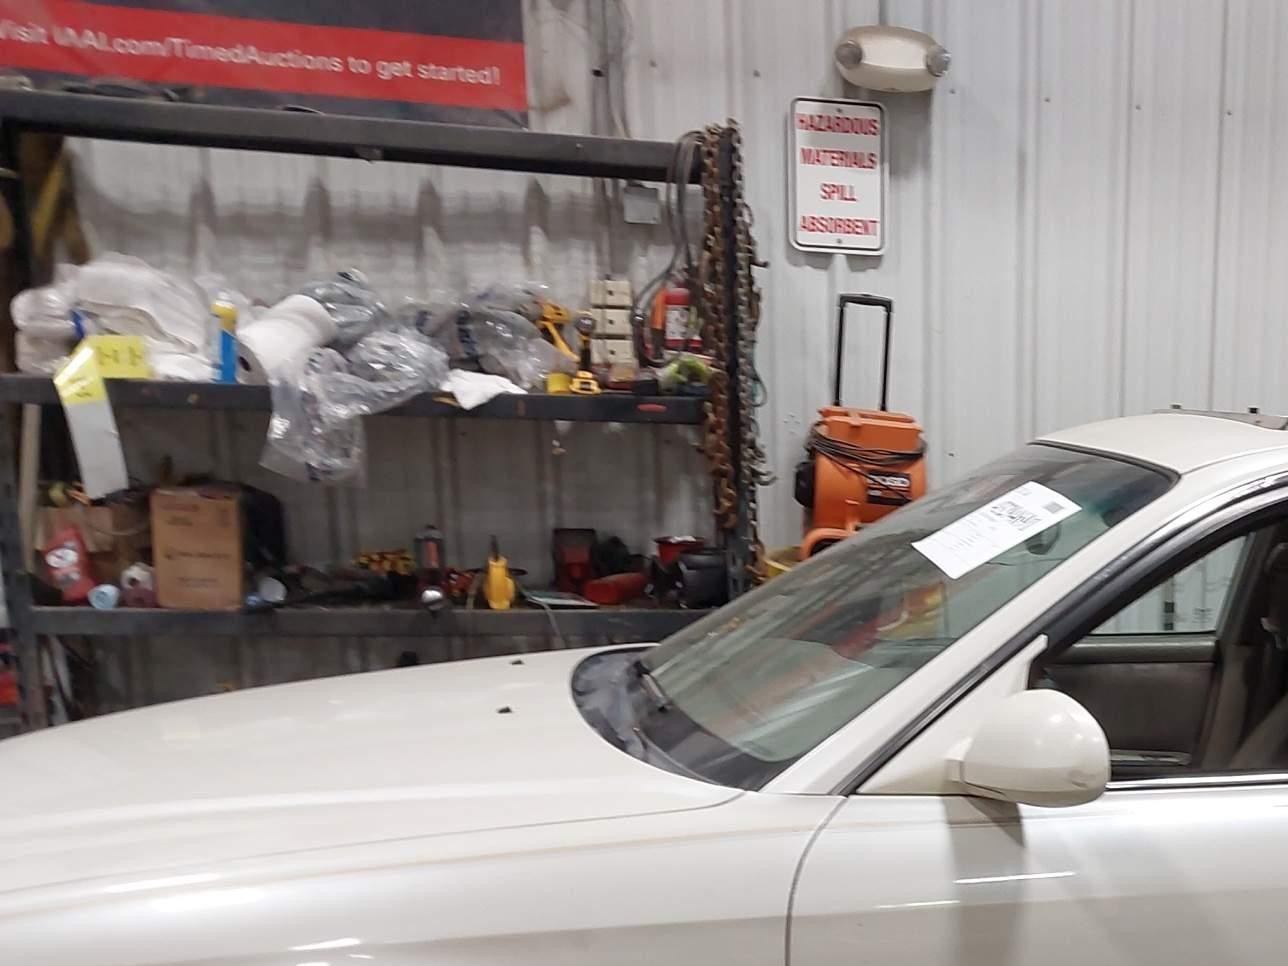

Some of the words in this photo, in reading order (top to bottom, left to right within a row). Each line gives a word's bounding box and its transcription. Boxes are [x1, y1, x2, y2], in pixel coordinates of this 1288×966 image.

[347, 56, 372, 75] to
[376, 60, 413, 80] get
[417, 62, 500, 85] started!
[795, 113, 880, 136] HAZARDOUS
[801, 147, 877, 169] MATERIALS
[820, 183, 857, 202] SPILL
[800, 216, 879, 236] ABSORBENT
